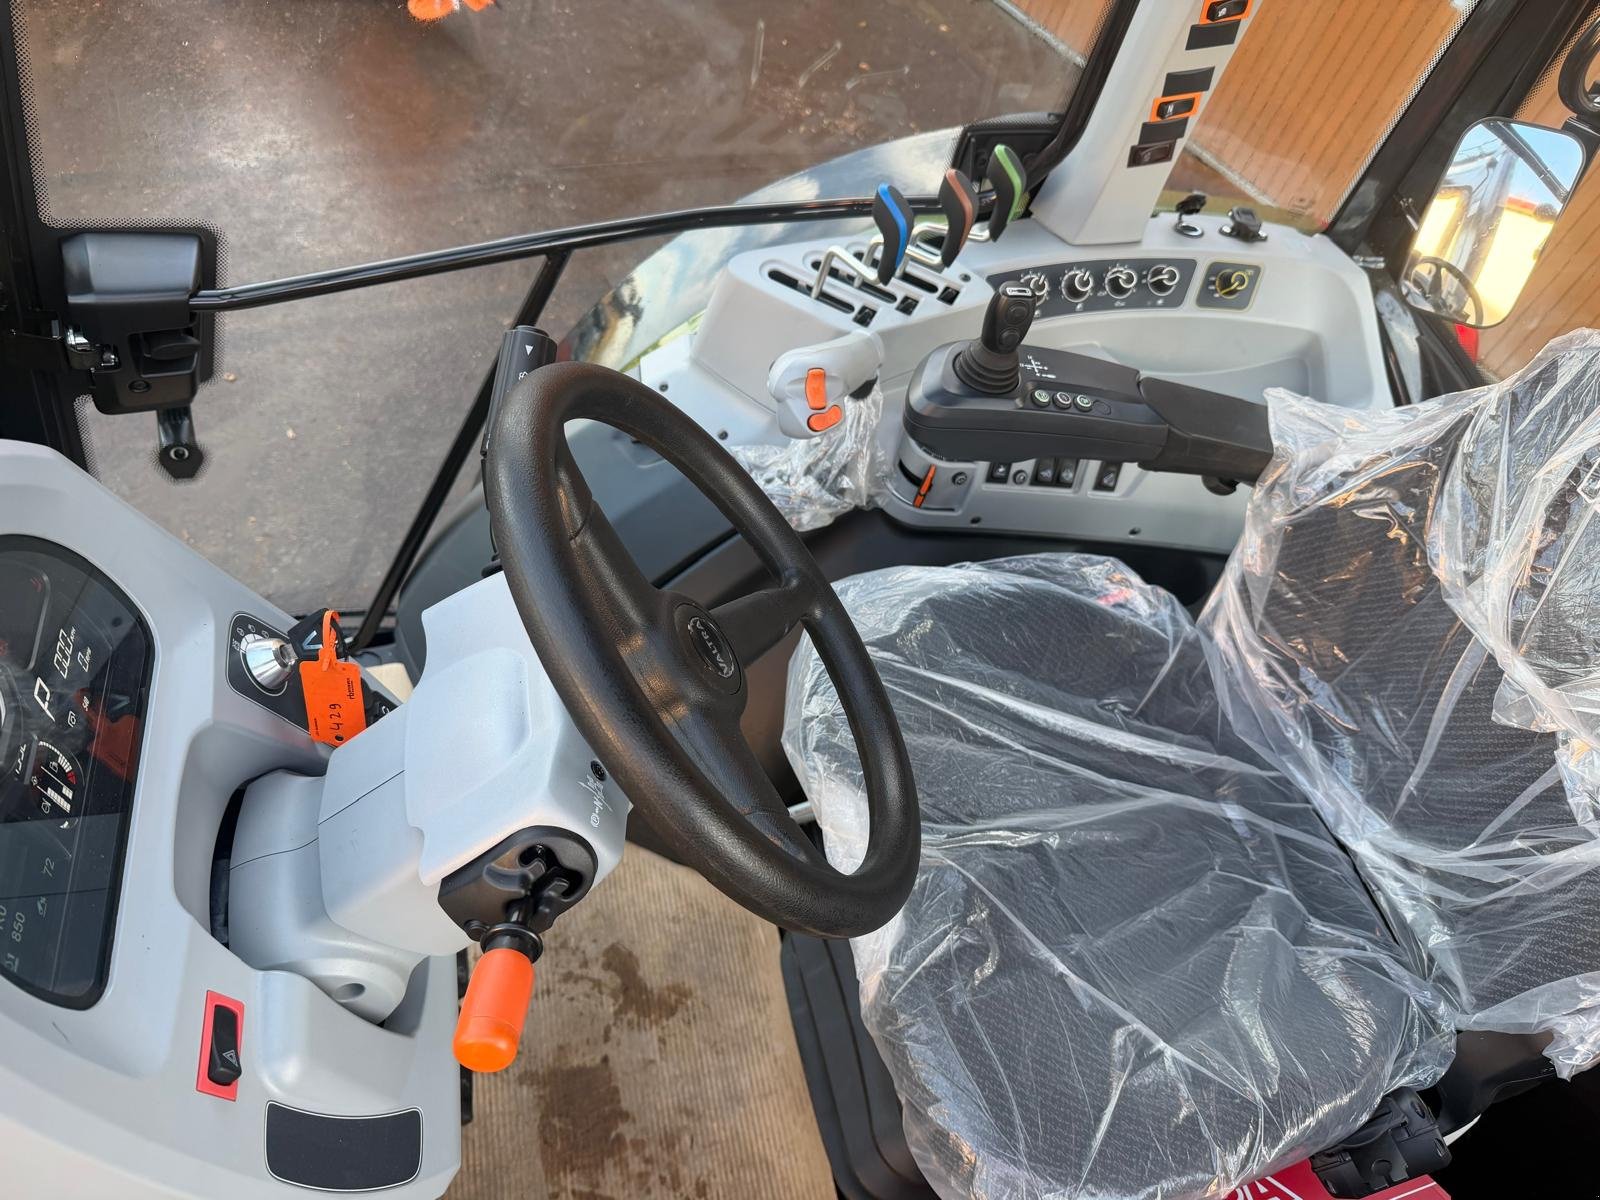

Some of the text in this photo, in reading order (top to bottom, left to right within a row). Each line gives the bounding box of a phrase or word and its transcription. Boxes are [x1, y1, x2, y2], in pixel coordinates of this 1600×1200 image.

[697, 620, 728, 674] VALTRA
[34, 676, 55, 722] P
[329, 703, 343, 731] 429
[41, 857, 55, 878] 72
[11, 911, 26, 942] 850
